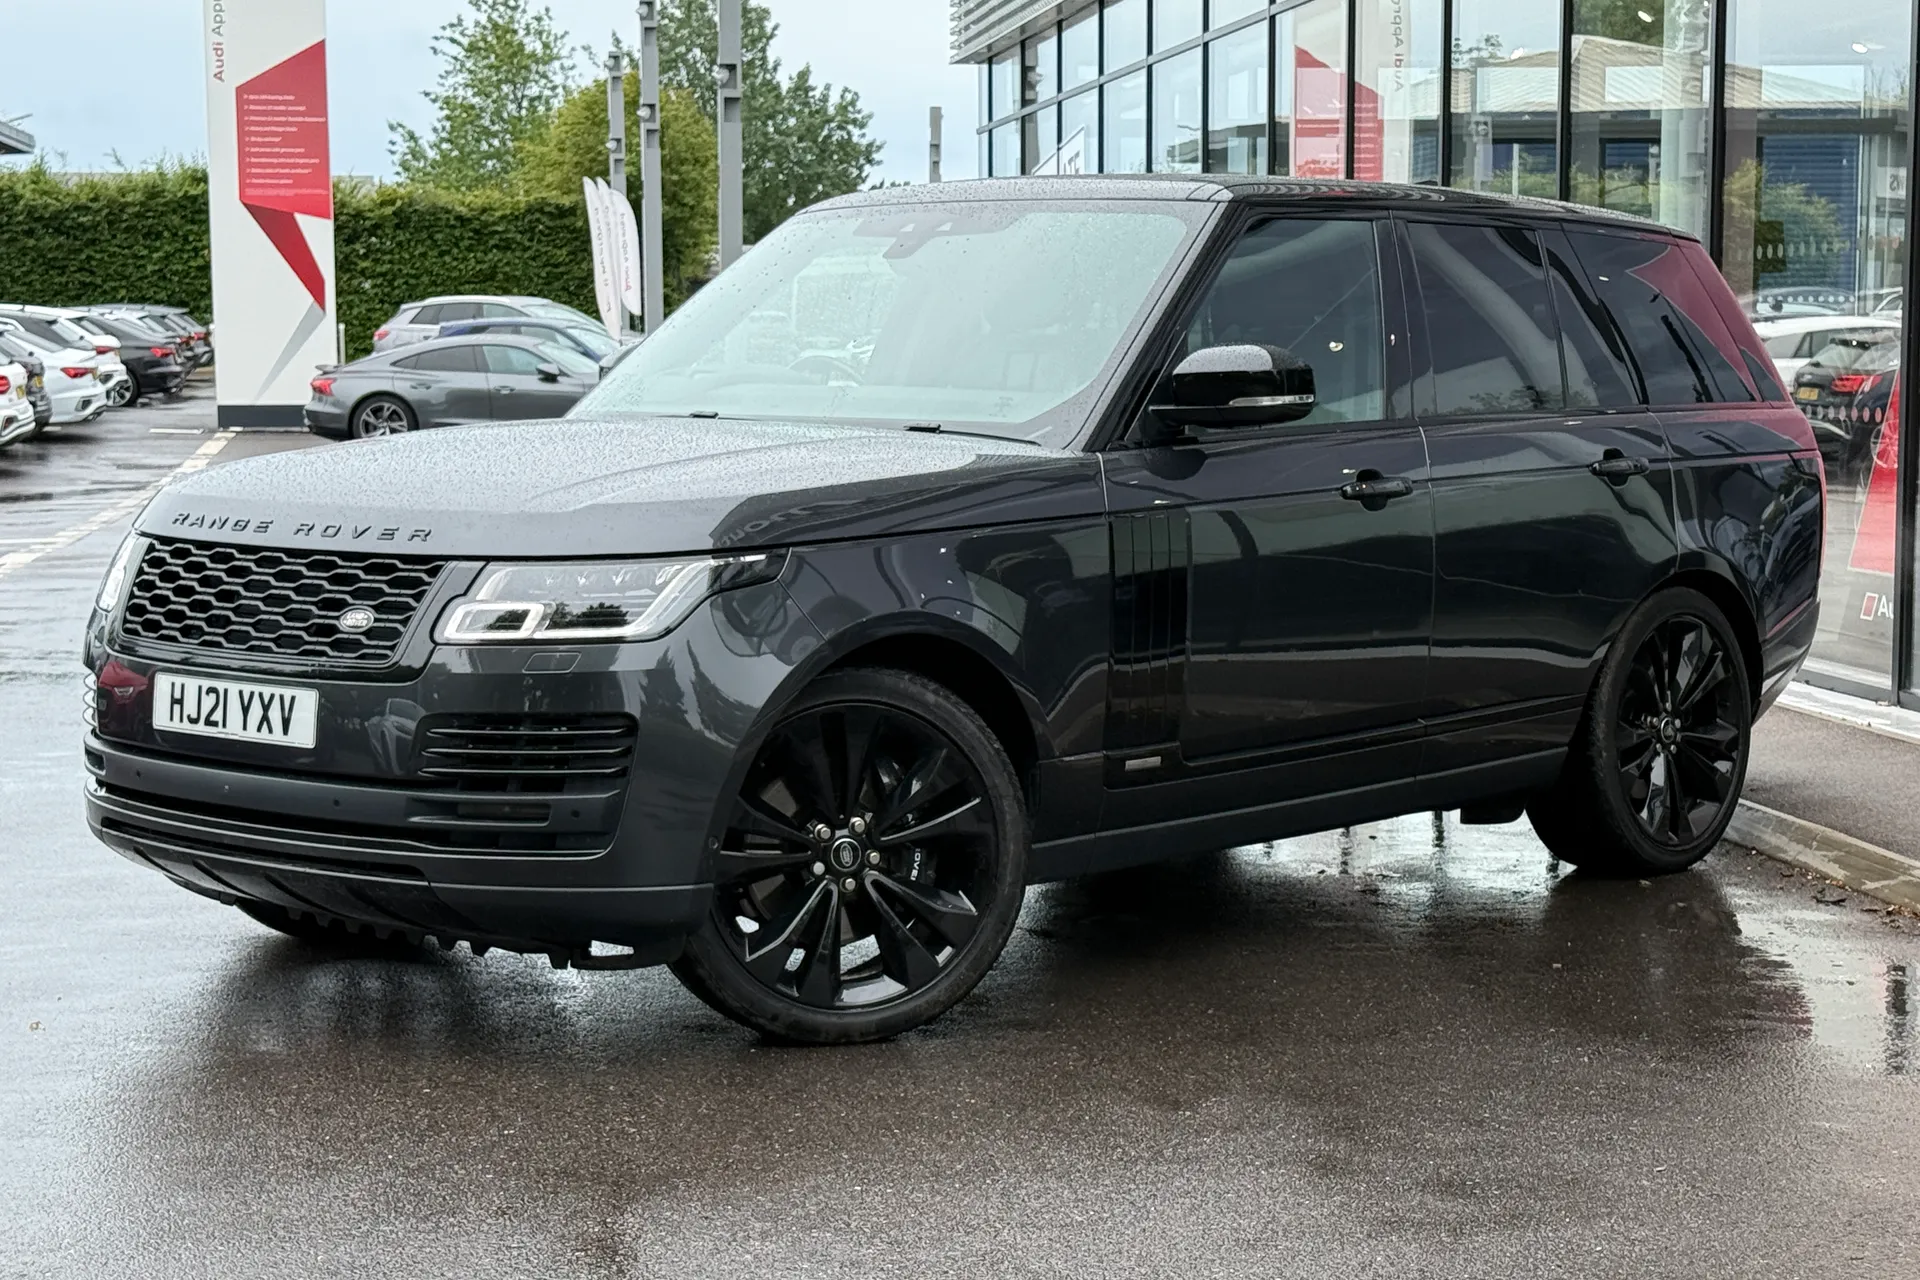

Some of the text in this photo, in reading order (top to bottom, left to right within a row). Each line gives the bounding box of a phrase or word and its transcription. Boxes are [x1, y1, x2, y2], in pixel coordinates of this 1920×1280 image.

[211, 0, 226, 83] Audi App
[172, 512, 432, 543] RANGE ROVER
[169, 681, 297, 737] HJ21 YXV
